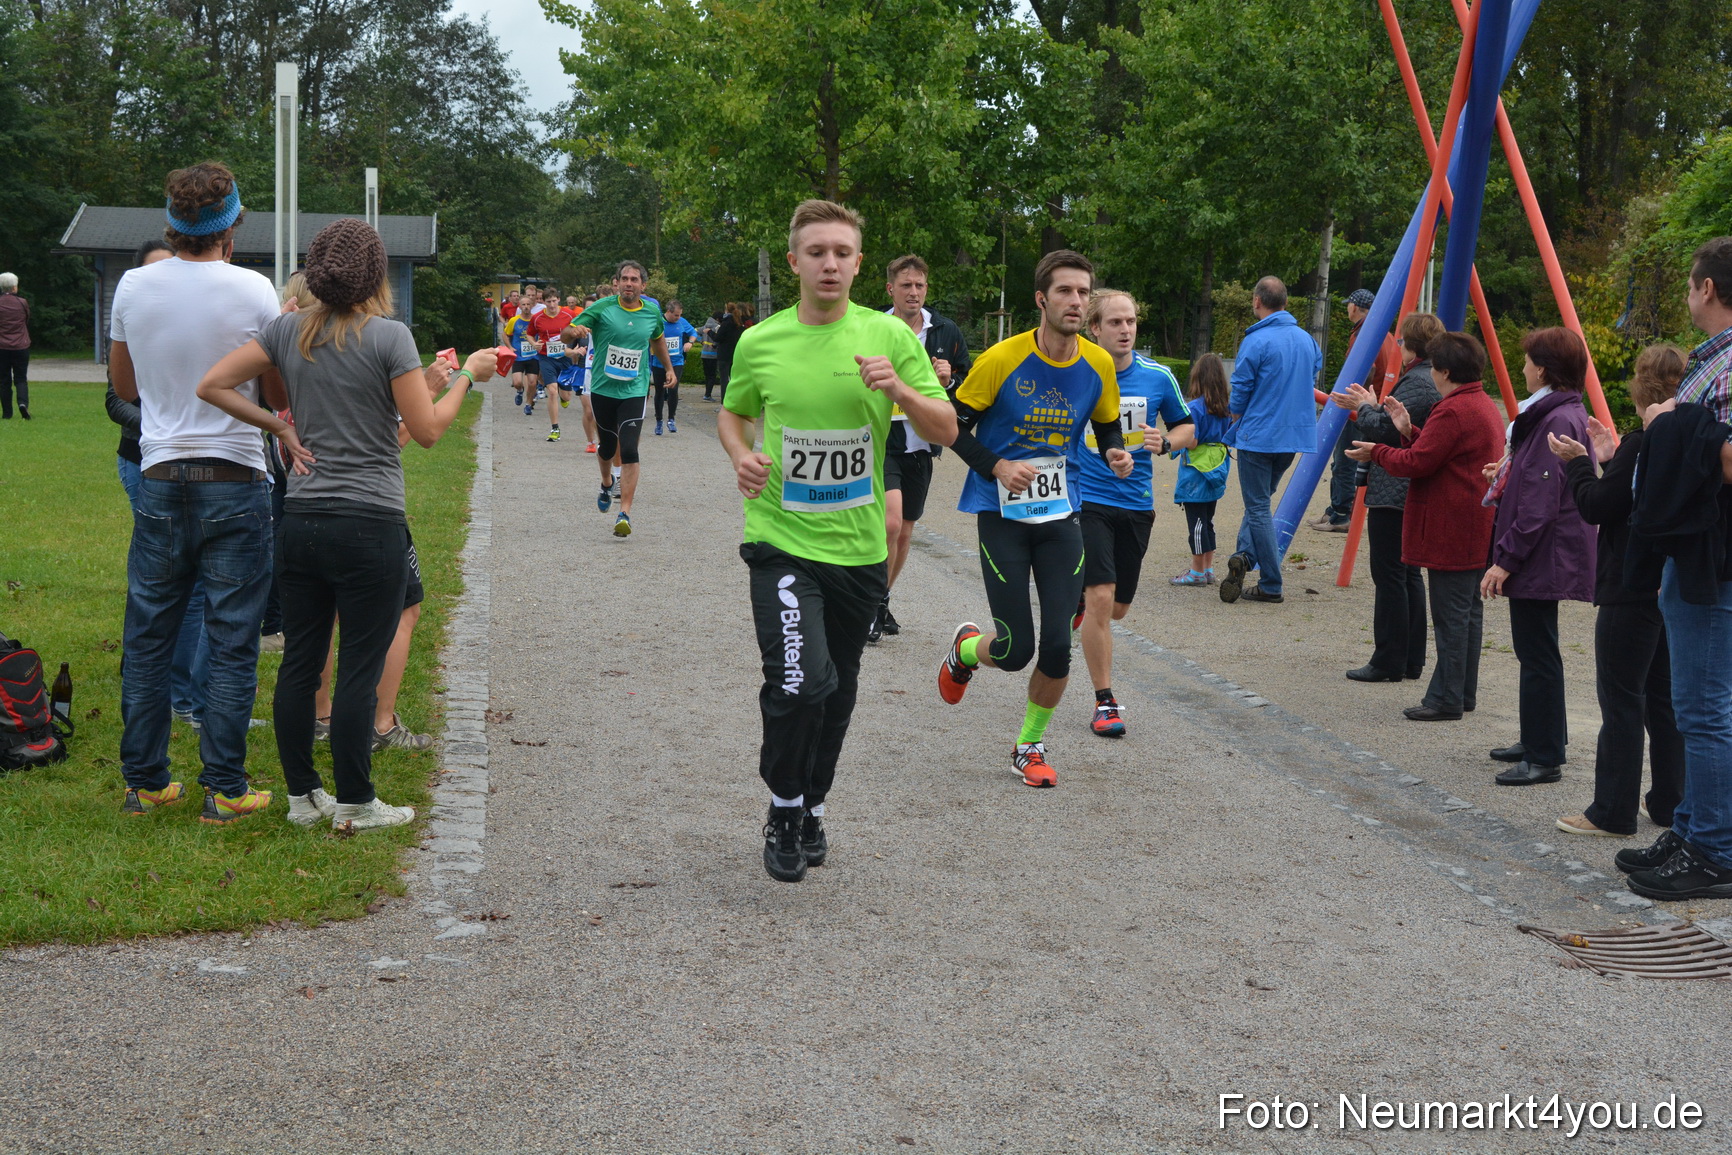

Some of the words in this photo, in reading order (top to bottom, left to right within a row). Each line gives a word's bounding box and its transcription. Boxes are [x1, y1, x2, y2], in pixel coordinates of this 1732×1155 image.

[609, 353, 638, 369] 3435
[784, 434, 812, 446] PARTL
[814, 438, 860, 446] Neumarkt
[790, 447, 866, 480] 2708
[809, 487, 848, 501] Daniel
[1026, 505, 1049, 516] Rene
[780, 609, 805, 695] Butterfly
